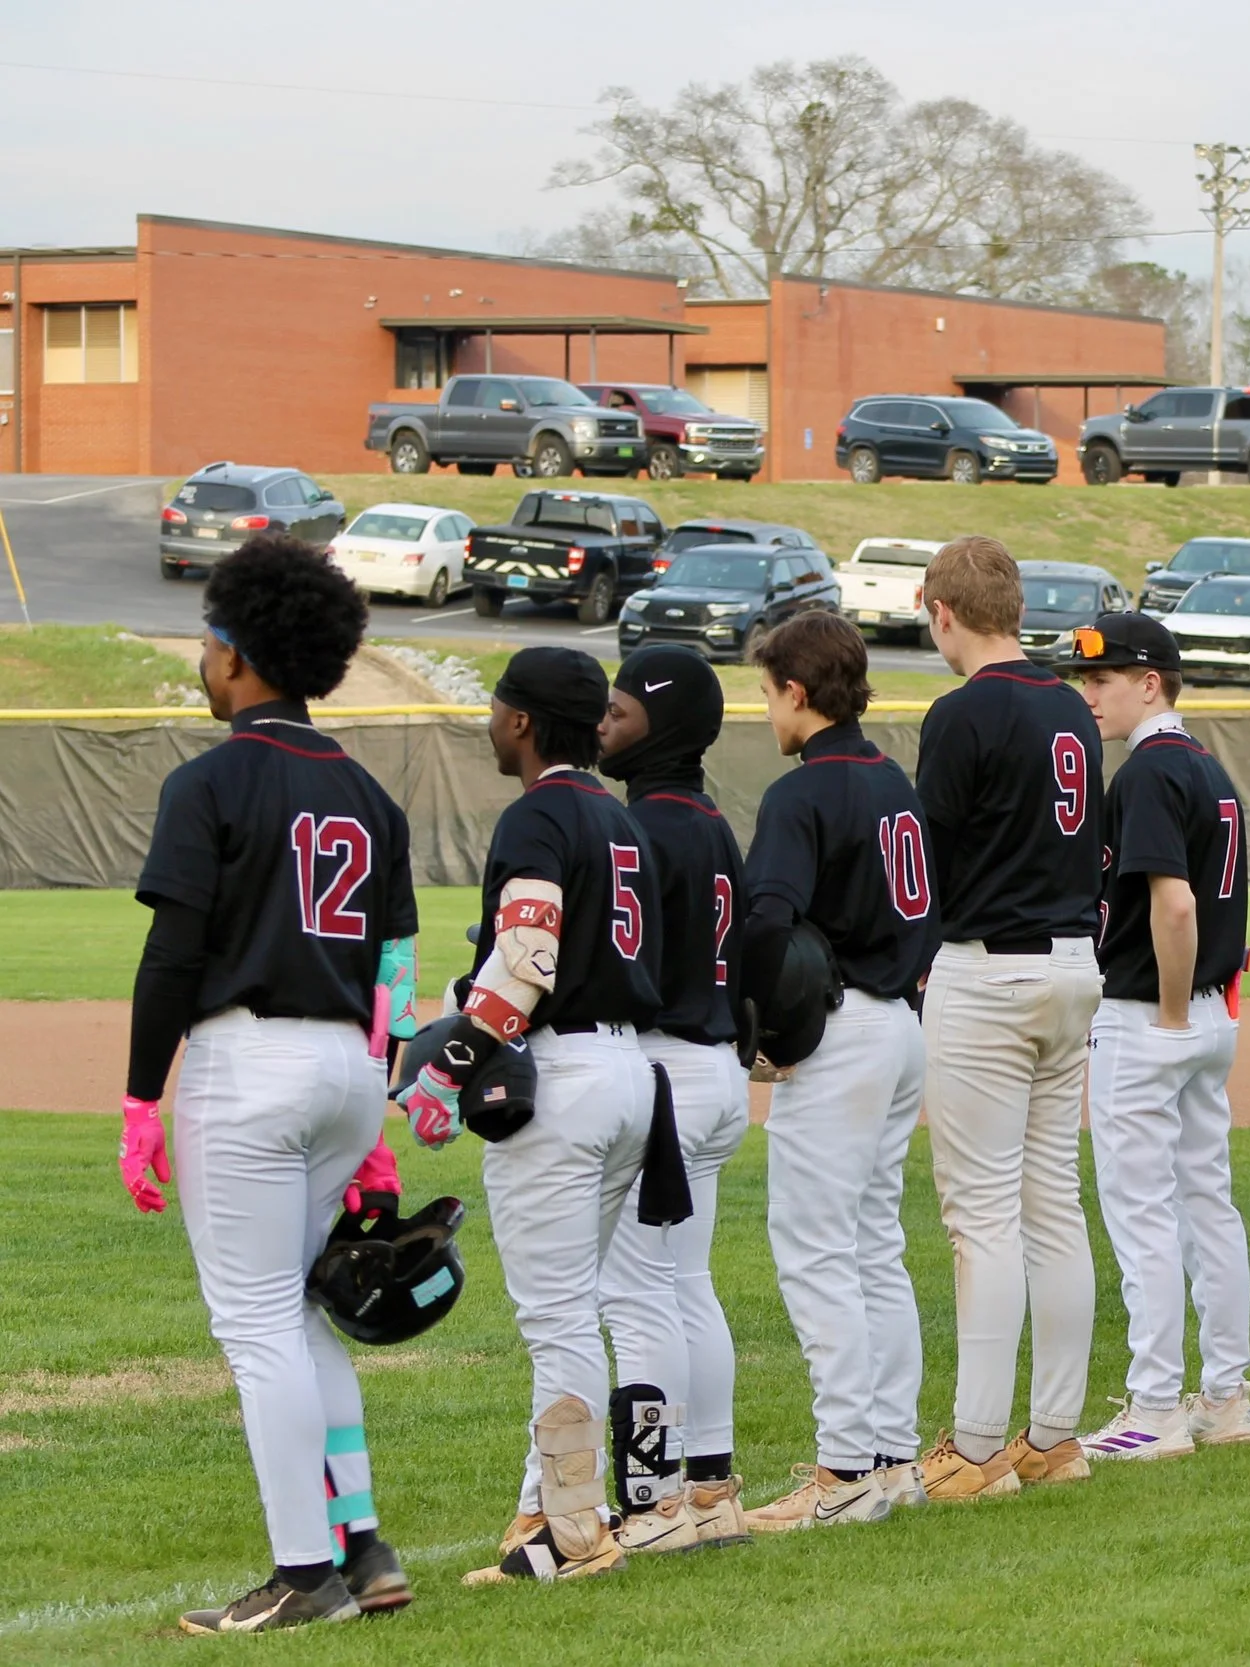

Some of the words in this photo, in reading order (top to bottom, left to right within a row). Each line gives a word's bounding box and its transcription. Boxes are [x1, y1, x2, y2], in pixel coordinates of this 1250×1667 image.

[1051, 731, 1087, 836] 9
[291, 812, 371, 940] 12
[609, 842, 643, 960] 5
[878, 810, 931, 921] 10
[1218, 798, 1239, 899] 7
[714, 873, 732, 985] 2
